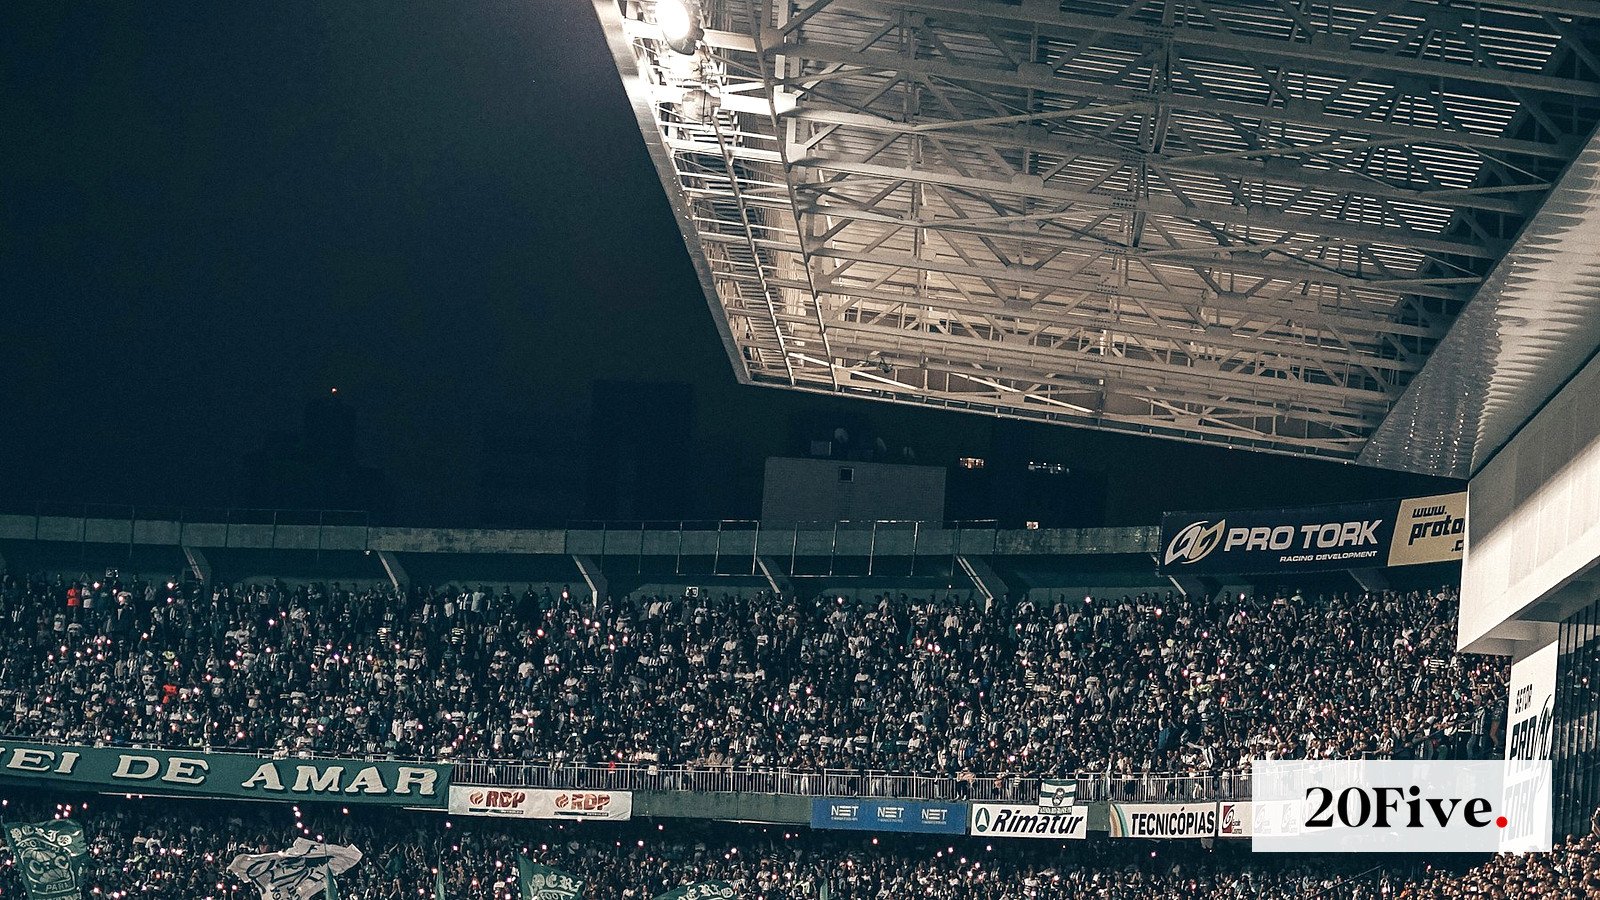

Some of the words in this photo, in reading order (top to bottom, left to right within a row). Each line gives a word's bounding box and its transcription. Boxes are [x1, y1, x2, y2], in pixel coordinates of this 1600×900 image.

[1412, 505, 1447, 518] www.
[1224, 525, 1294, 552] PRO
[1302, 519, 1383, 549] TORK
[1408, 515, 1465, 545] proto
[1279, 554, 1313, 563] RACING
[1315, 550, 1378, 562] DEVELOPMENT
[0, 747, 80, 774] EI
[112, 755, 209, 784] DE
[241, 763, 438, 796] AMAR
[831, 805, 859, 817] NET
[877, 807, 905, 818] NET
[921, 809, 948, 820] NET
[991, 809, 1084, 834] Rimatur
[1131, 807, 1215, 836] TECNICÓPIAS
